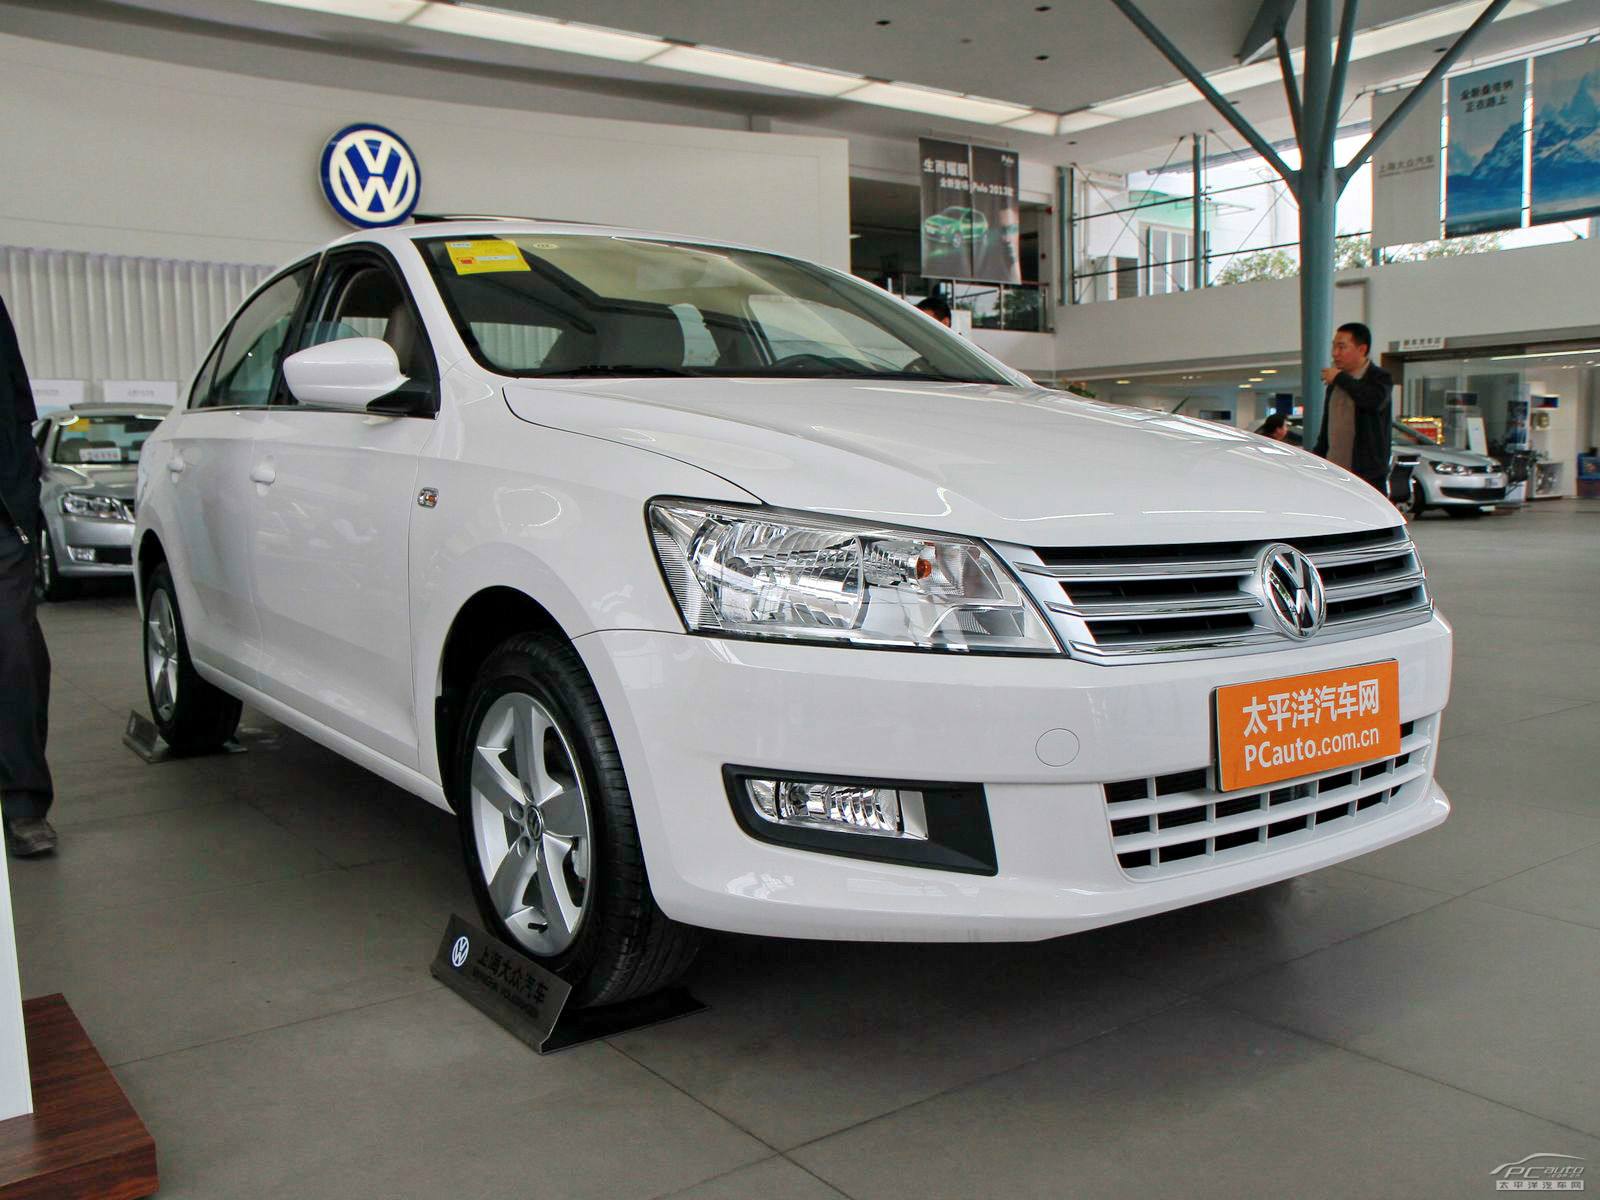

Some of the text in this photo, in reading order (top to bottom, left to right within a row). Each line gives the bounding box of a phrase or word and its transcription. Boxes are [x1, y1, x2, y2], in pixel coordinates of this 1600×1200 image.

[1242, 679, 1380, 738] 太平洋汽车网
[1244, 727, 1380, 771] PCauto.com.cn
